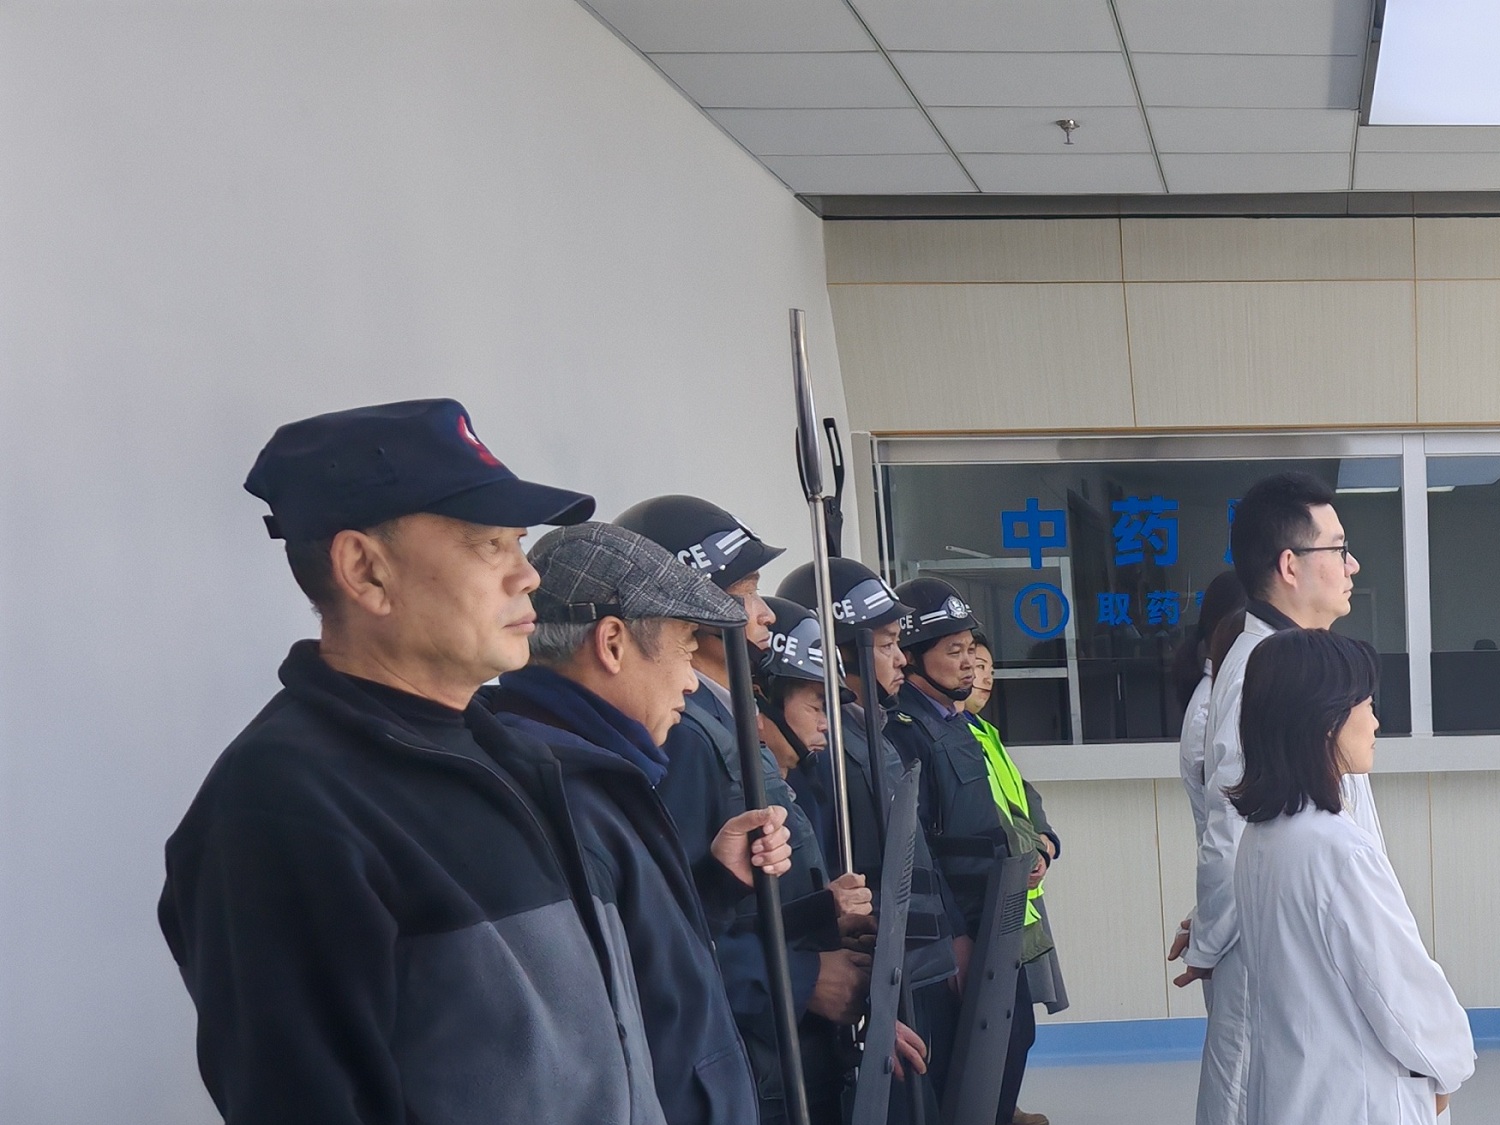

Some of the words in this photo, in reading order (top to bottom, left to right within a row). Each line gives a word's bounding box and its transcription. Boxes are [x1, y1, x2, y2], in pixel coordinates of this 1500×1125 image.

[1001, 496, 1242, 570] 中药
[677, 543, 713, 569] CE
[900, 614, 914, 630] CE
[1096, 591, 1205, 626] 取药
